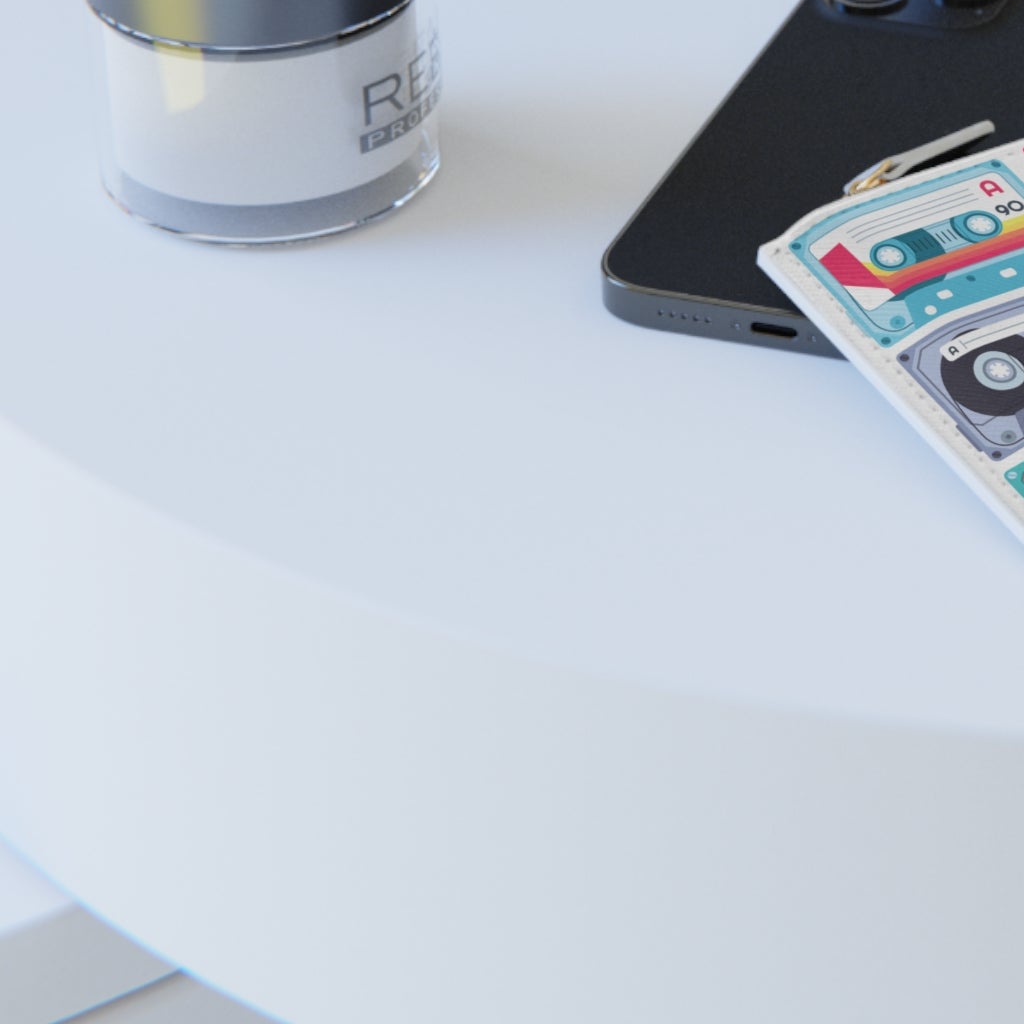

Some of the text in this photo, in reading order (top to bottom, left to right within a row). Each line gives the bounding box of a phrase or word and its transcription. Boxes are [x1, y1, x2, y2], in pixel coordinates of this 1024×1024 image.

[979, 180, 1005, 198] A
[995, 200, 1024, 216] 90
[948, 346, 960, 356] A
